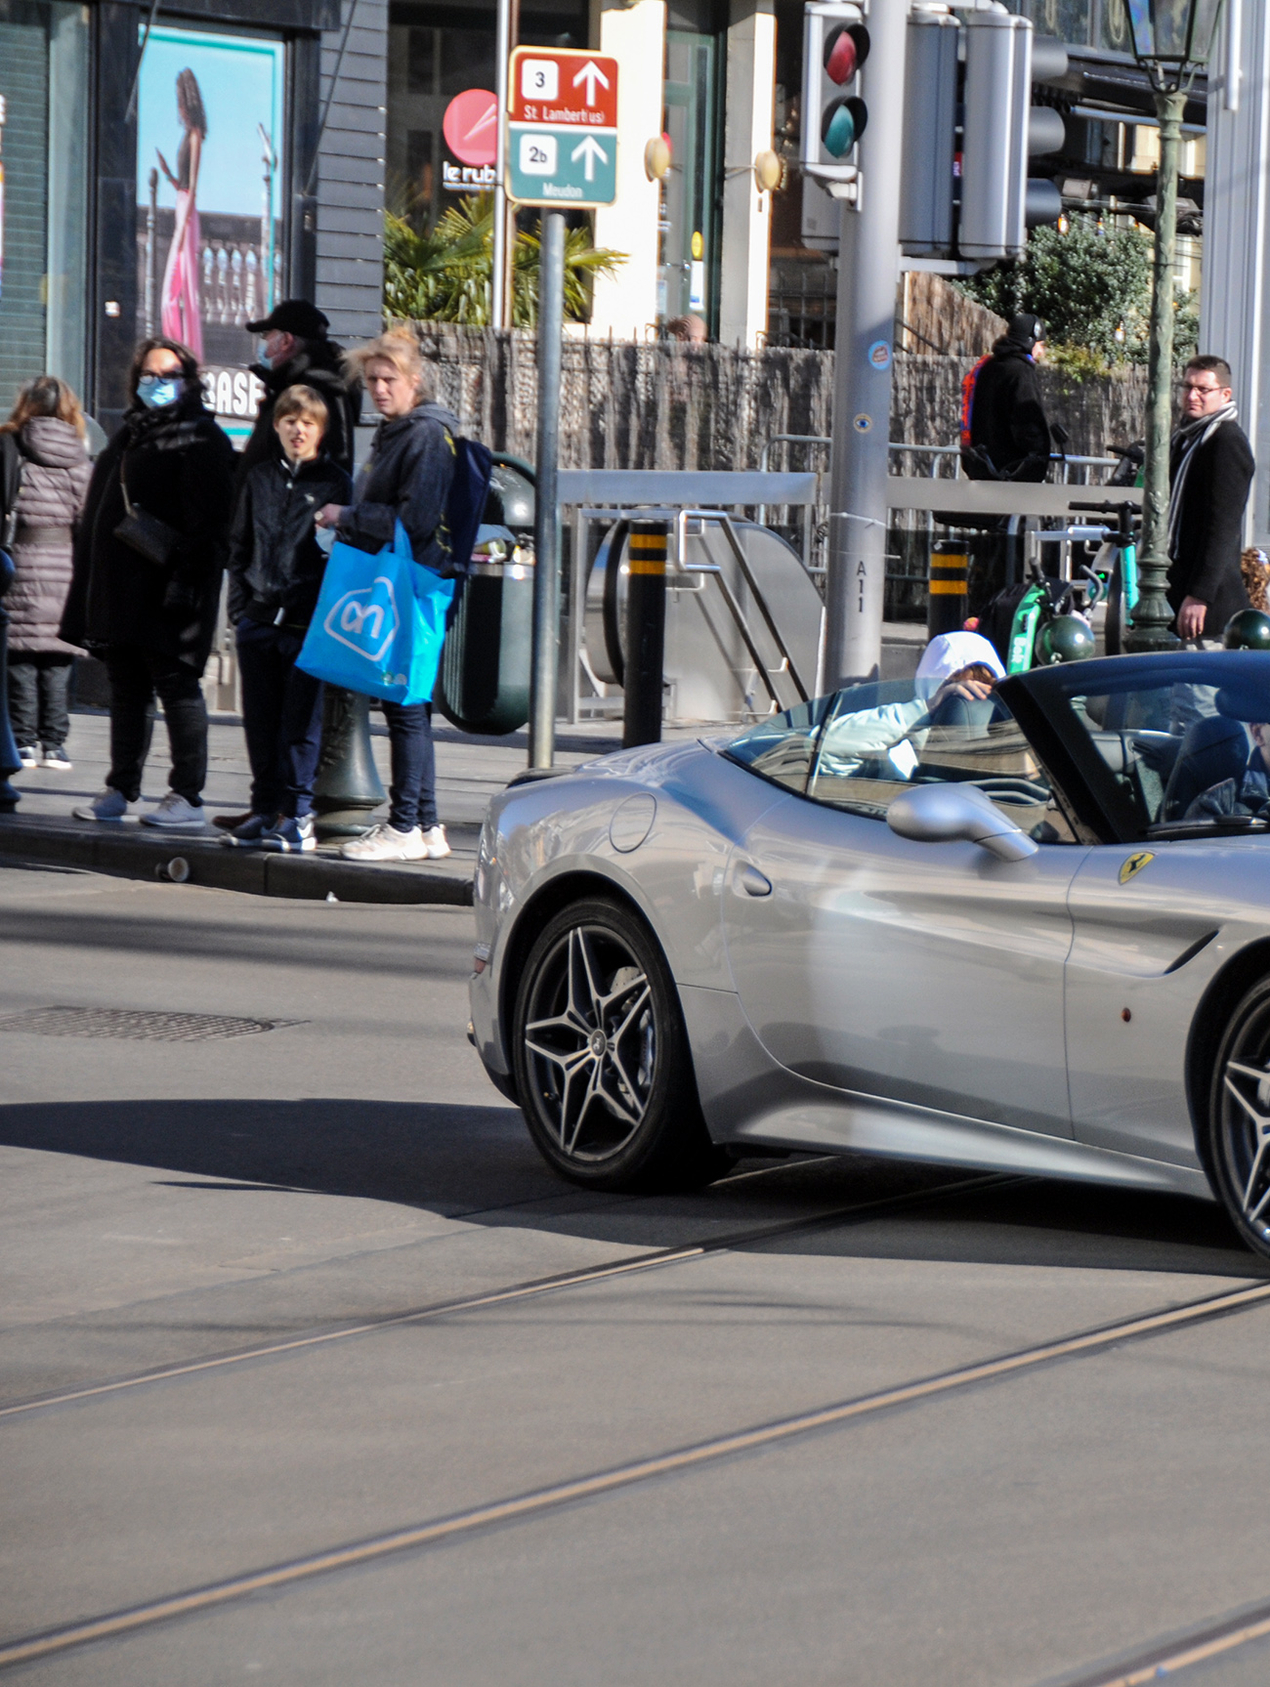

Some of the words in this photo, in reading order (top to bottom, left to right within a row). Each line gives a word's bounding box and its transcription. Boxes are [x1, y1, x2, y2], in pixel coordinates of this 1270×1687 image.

[535, 71, 546, 88] 3
[529, 146, 548, 163] 2b
[462, 164, 497, 184] rub
[542, 182, 583, 198] Meudon
